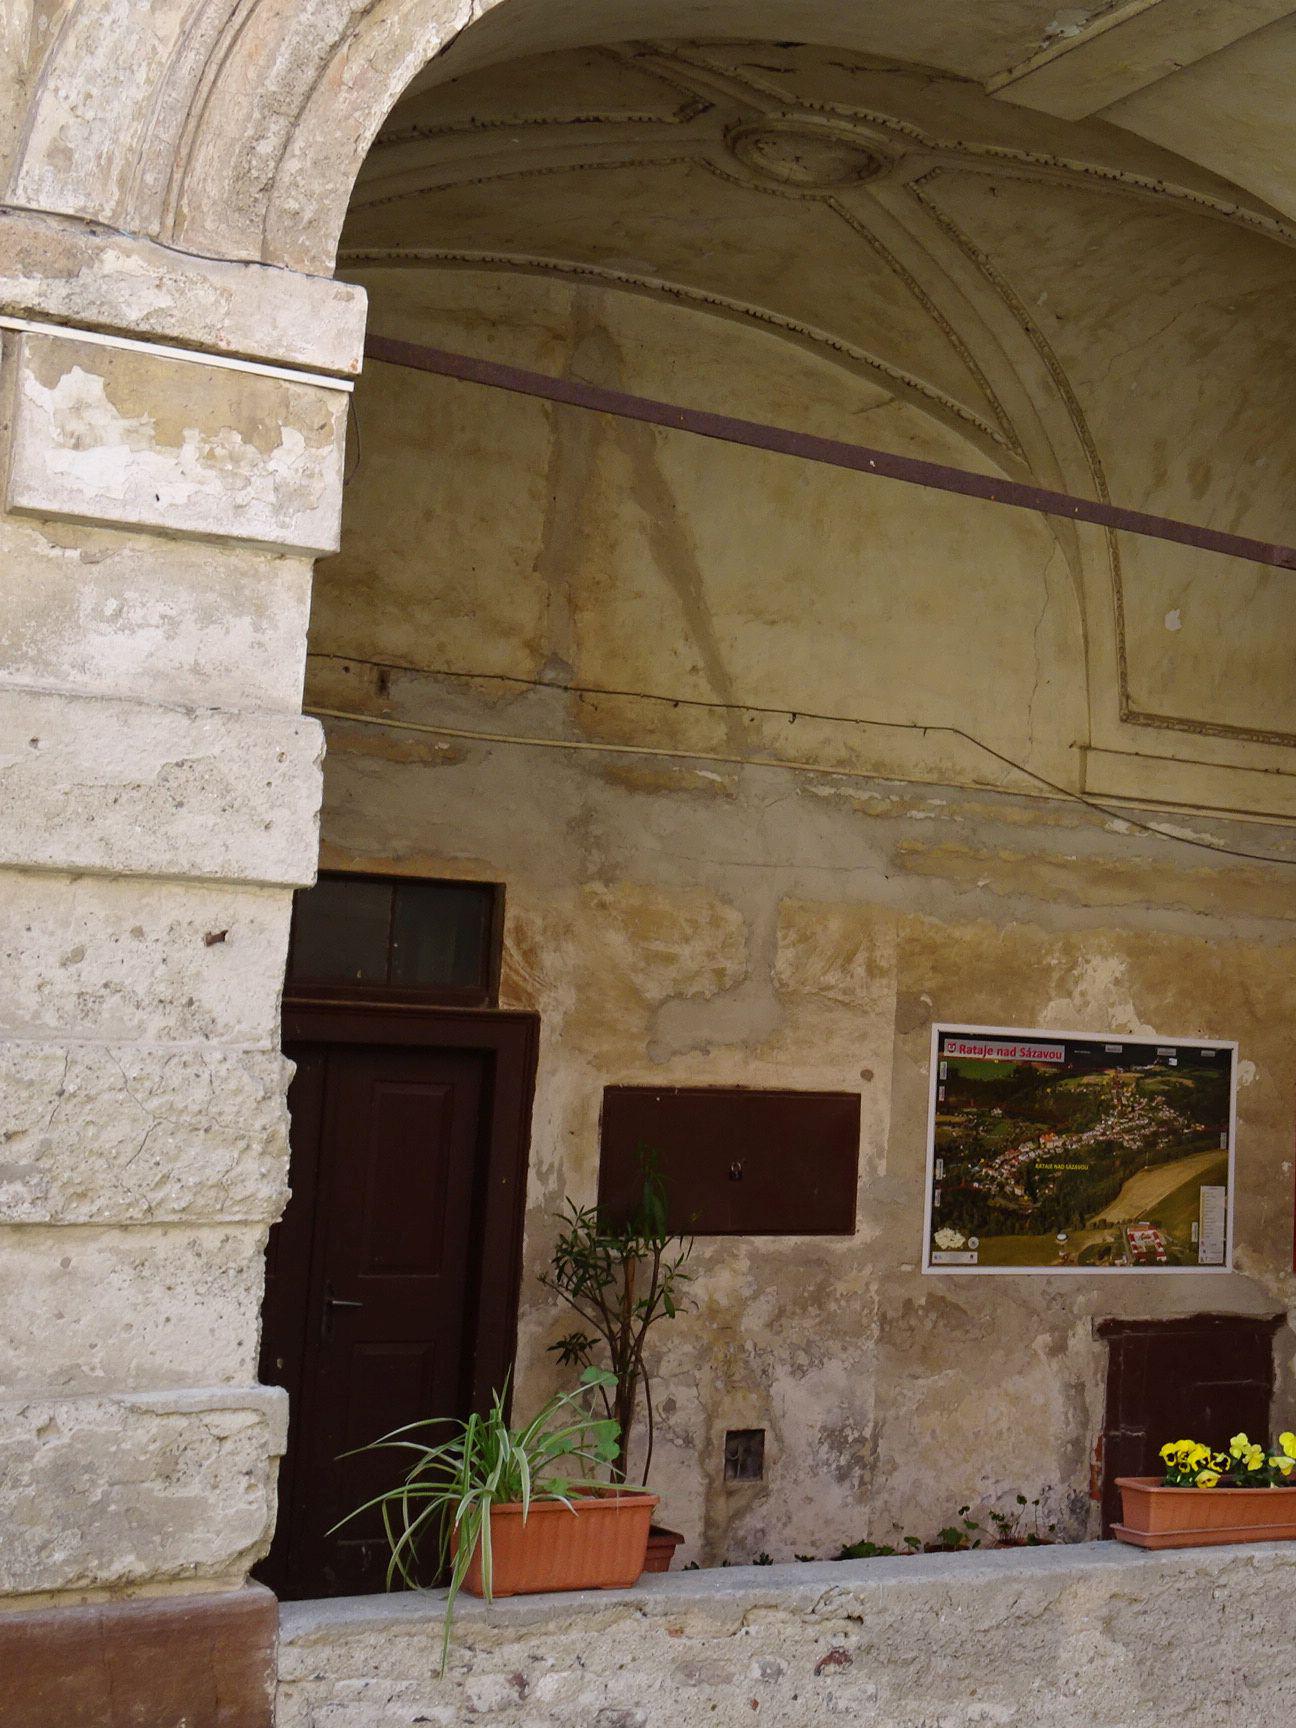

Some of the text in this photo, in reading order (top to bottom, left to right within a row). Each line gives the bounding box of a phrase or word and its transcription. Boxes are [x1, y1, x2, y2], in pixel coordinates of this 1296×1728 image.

[959, 1044, 1062, 1060] Rataje nad Sázavou
